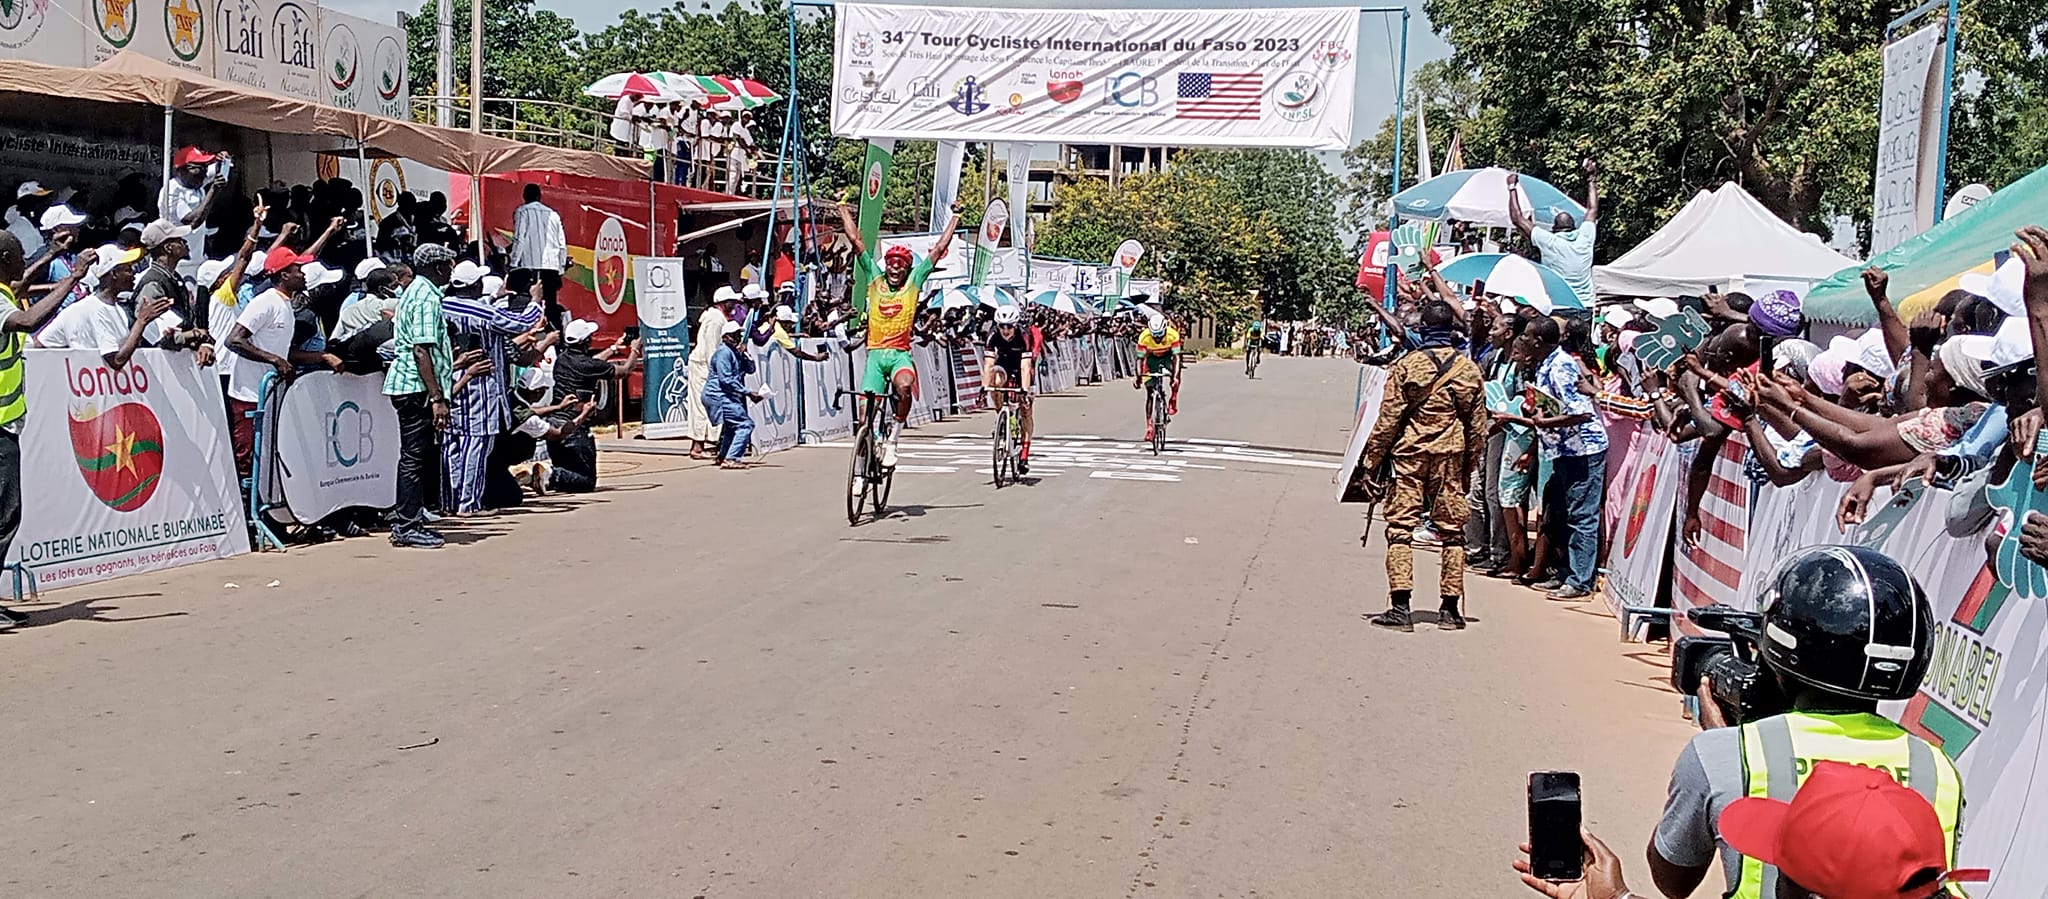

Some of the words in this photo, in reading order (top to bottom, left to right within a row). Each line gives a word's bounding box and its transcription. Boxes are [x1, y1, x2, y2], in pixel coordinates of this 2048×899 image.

[224, 9, 264, 59] Lafi
[279, 22, 316, 69] Lafi
[920, 32, 962, 46] Tour
[967, 34, 1040, 51] Cycliste
[1047, 37, 1167, 52] International
[1173, 38, 1196, 51] du
[1202, 38, 1247, 51] Faso
[1253, 38, 1300, 51] 2023
[1103, 71, 1159, 108] BCB
[0, 134, 45, 152] ycliste
[325, 400, 374, 468] BCB
[20, 535, 84, 563] LOTERIE
[88, 524, 160, 552] NATIONALE
[39, 571, 57, 583] Les
[58, 568, 75, 580] lots
[77, 567, 94, 577] aux
[95, 558, 137, 576] gagnants,
[137, 554, 150, 565] les
[1923, 620, 2002, 727] ONABEL
